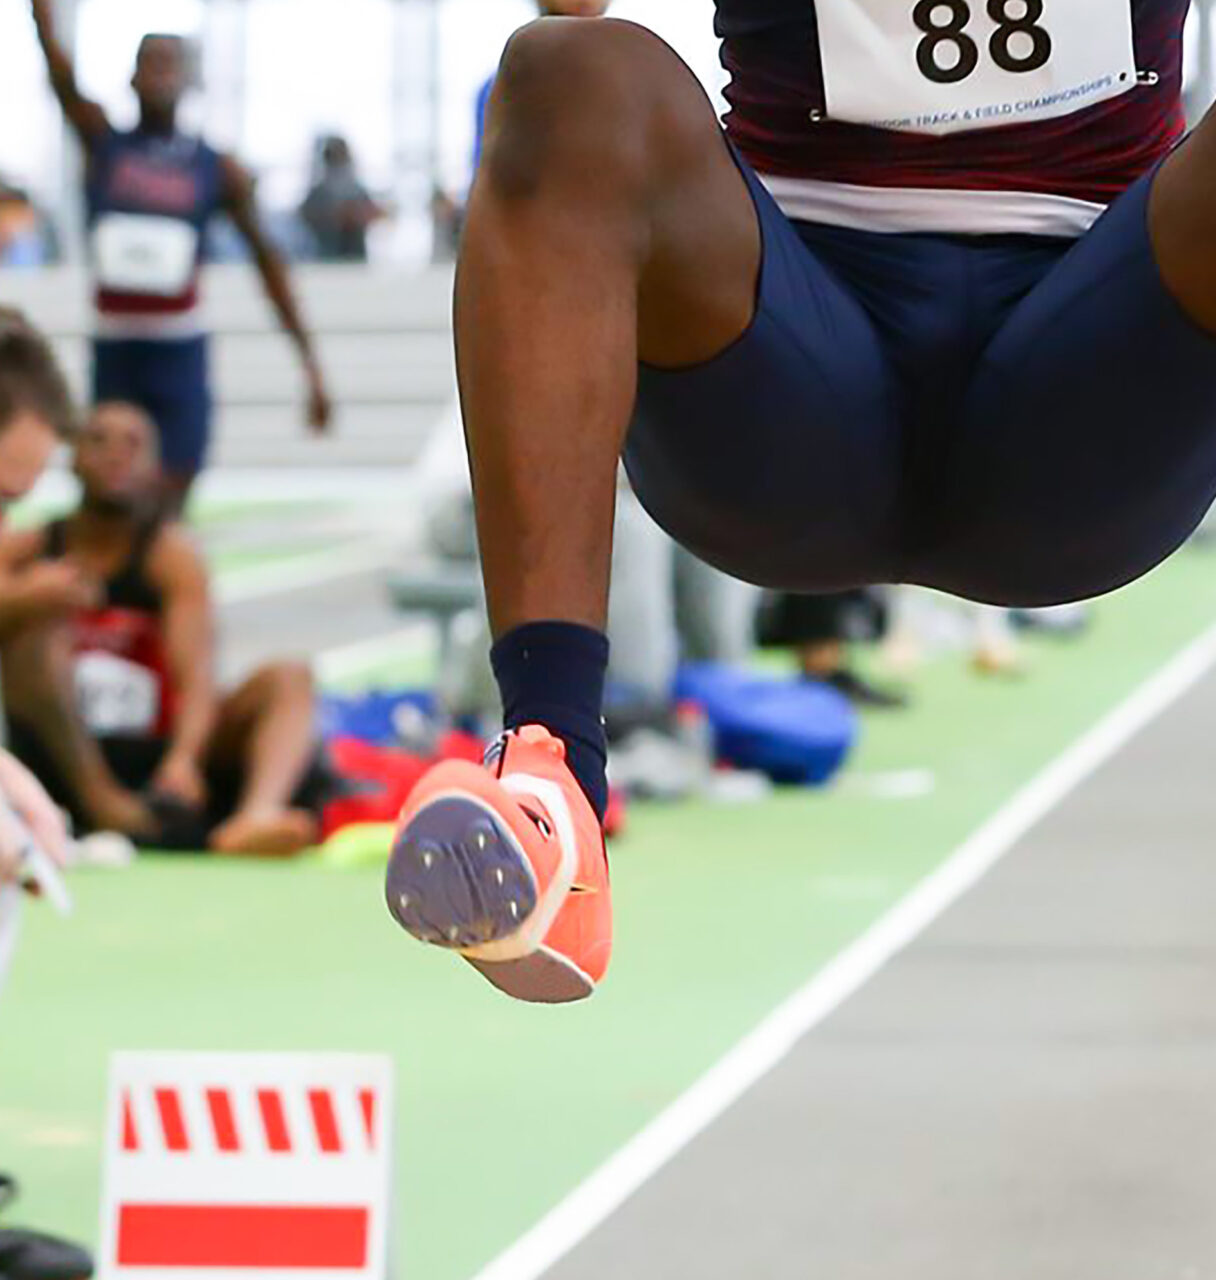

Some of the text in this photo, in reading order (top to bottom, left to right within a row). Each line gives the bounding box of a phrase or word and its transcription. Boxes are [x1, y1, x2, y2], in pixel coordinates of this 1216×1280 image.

[916, 113, 957, 128] TRACK
[975, 104, 1012, 120] FIELD
[1014, 75, 1113, 112] CHAMPIONSHIPS
